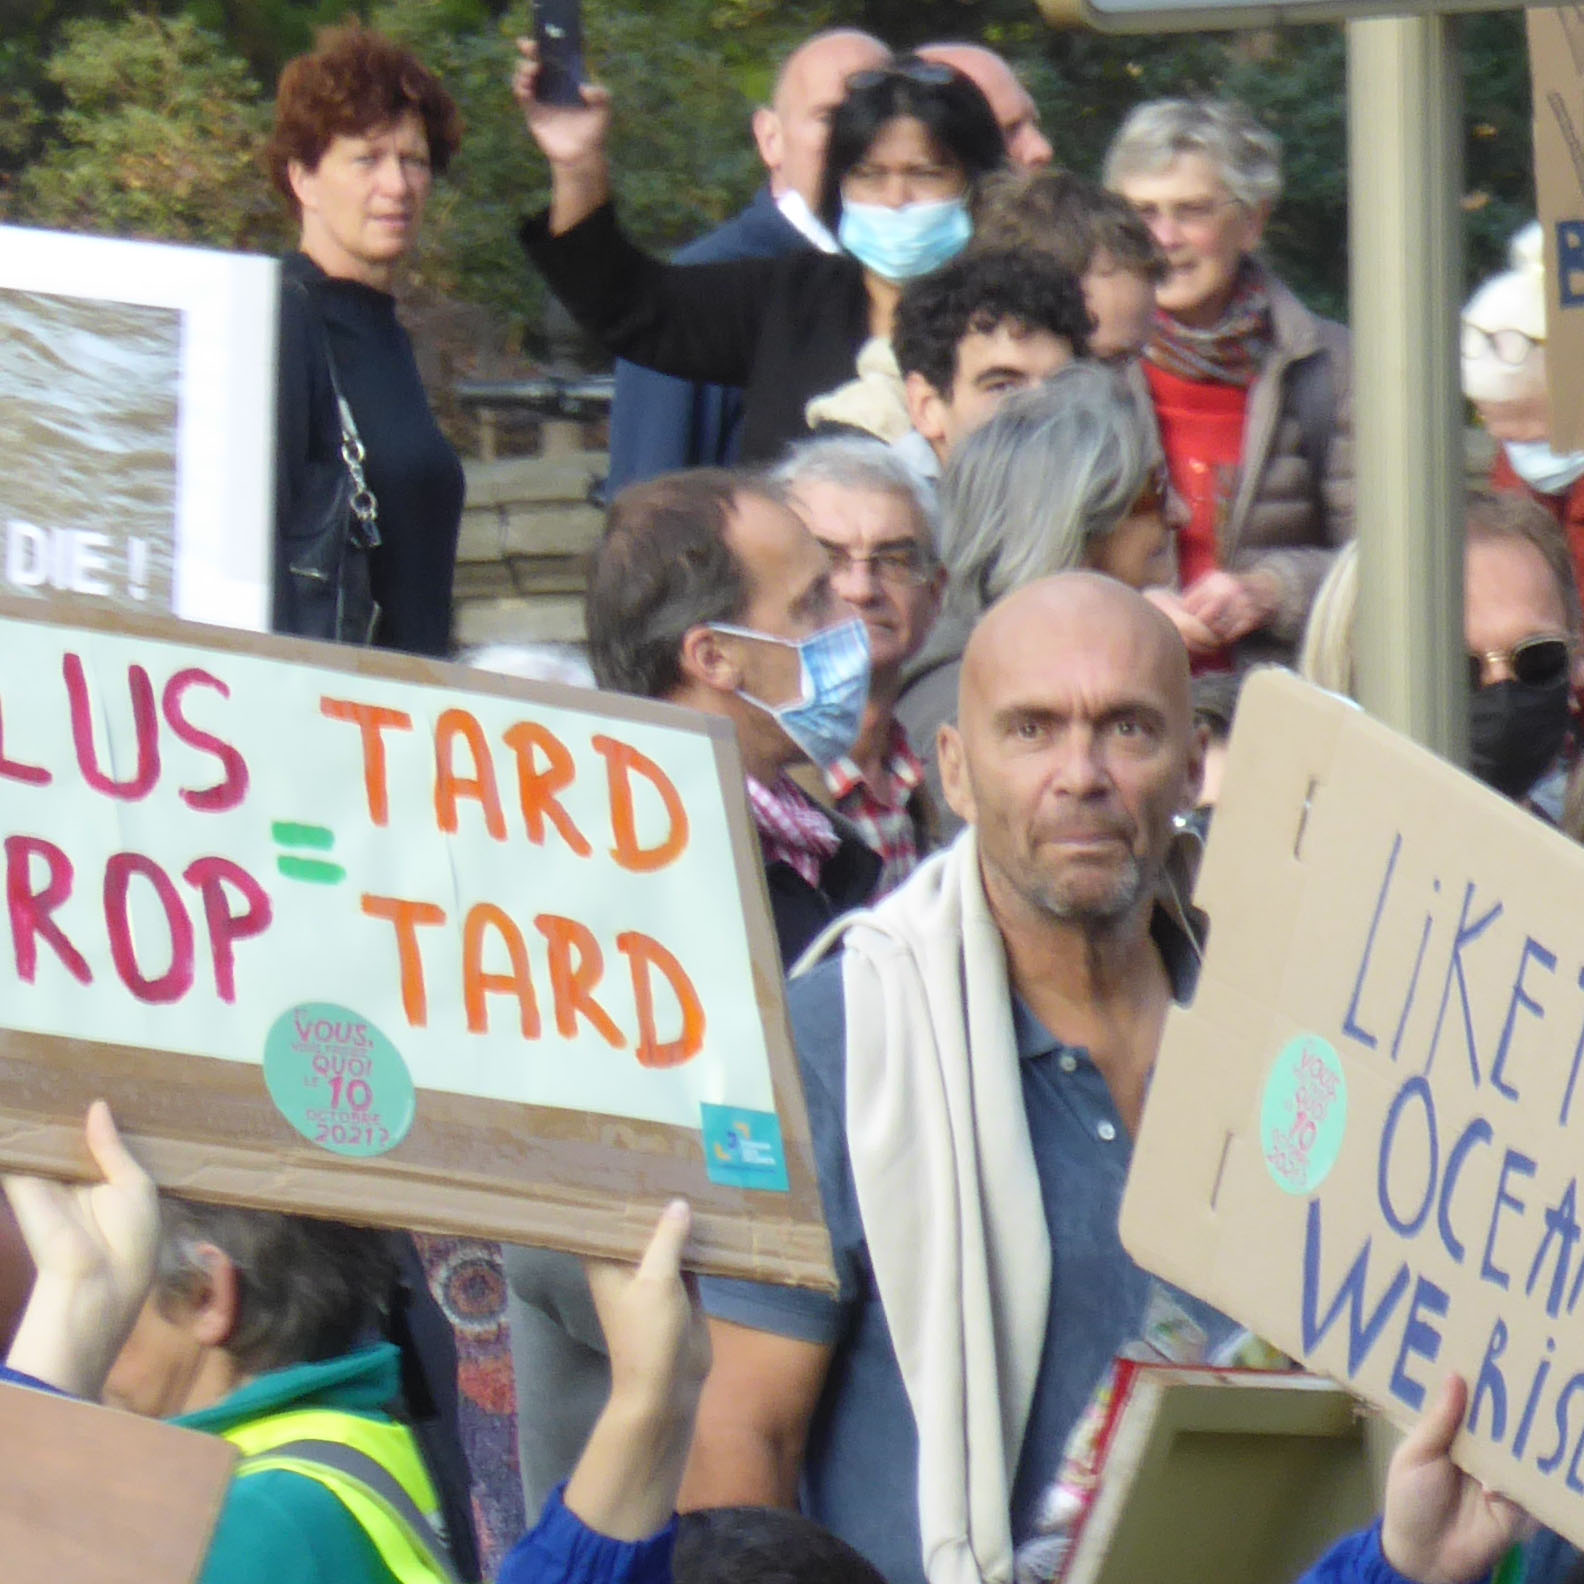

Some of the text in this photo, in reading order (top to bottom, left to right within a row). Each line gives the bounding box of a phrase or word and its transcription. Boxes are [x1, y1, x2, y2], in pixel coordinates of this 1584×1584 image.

[7, 521, 107, 595] DIE
[318, 695, 691, 874] TARD
[4, 834, 707, 1070] ROP TARD
[315, 1123, 391, 1148] 2021?
[327, 1075, 374, 1113] 10
[1300, 1198, 1450, 1413] WE
